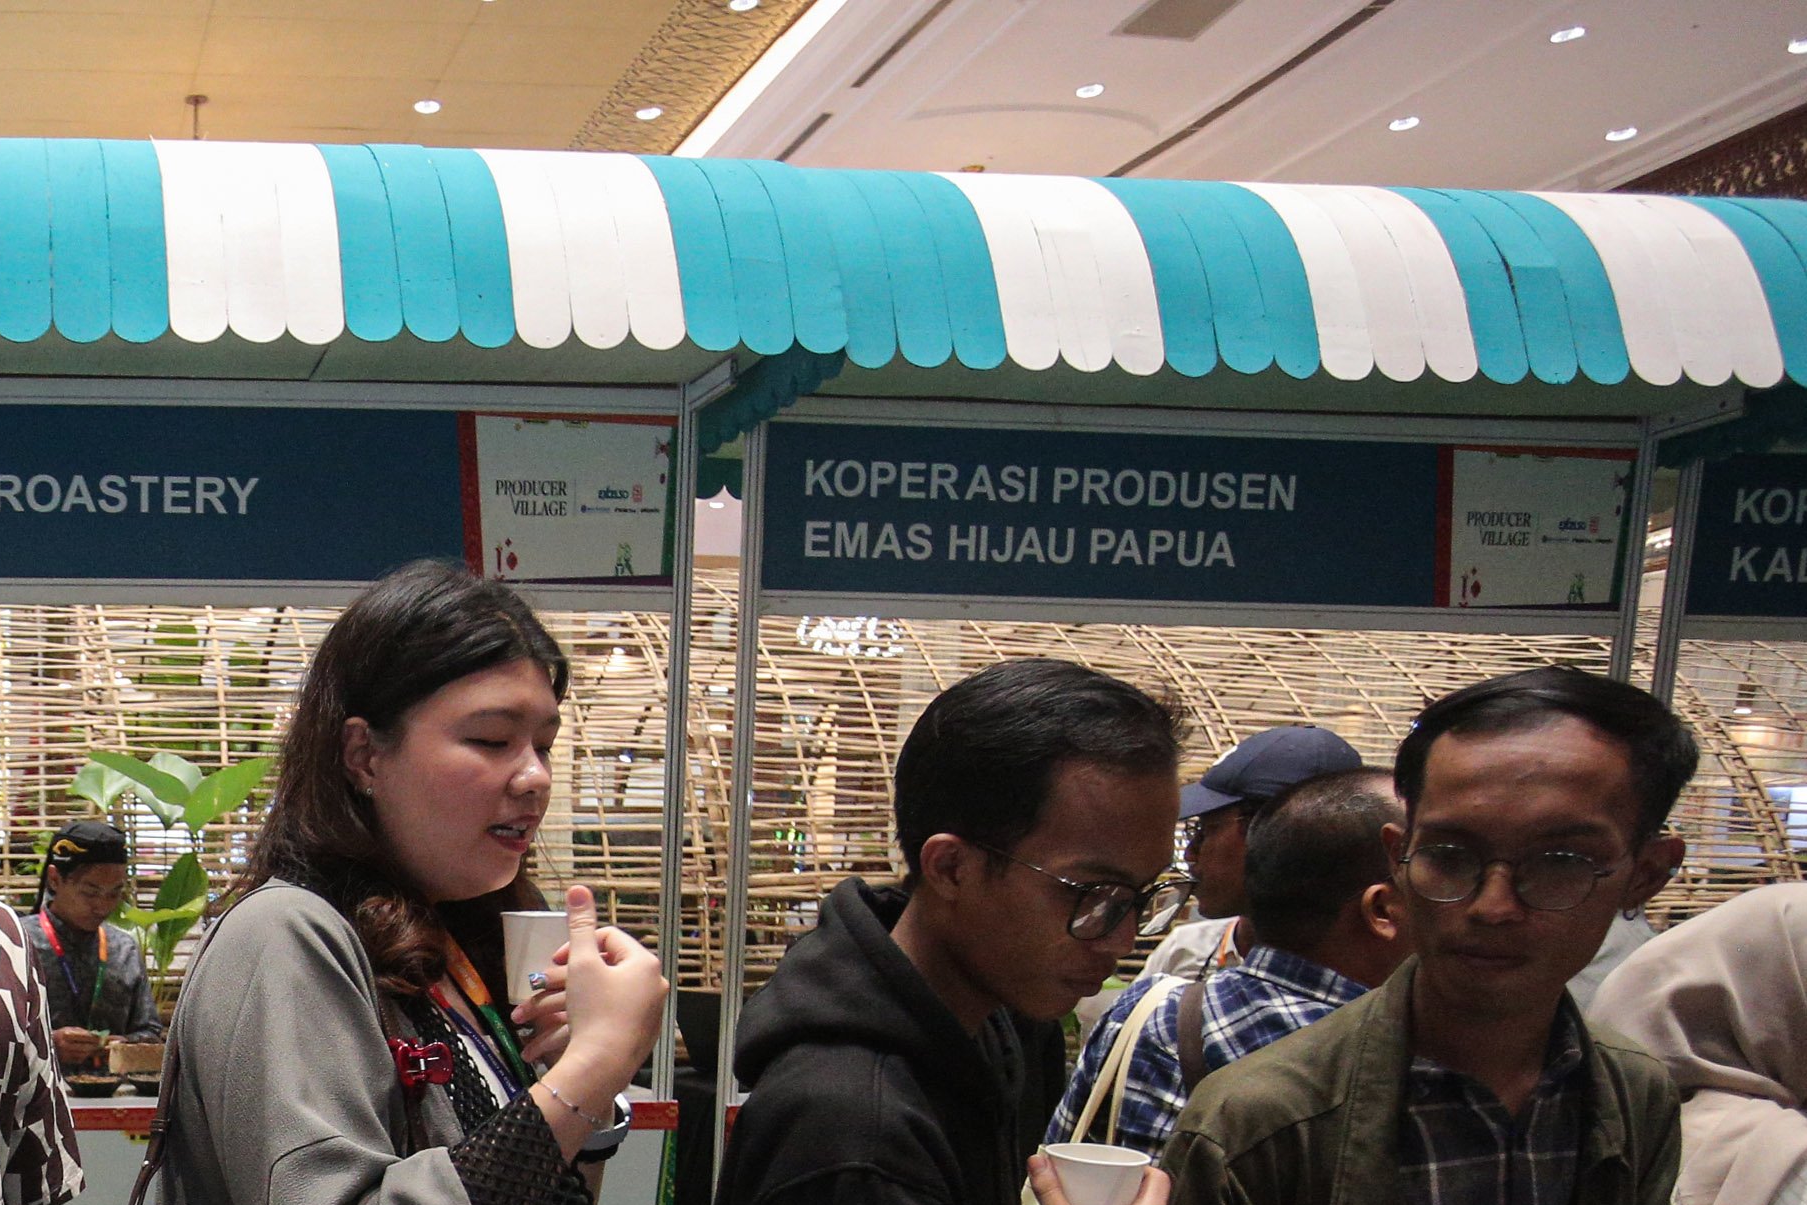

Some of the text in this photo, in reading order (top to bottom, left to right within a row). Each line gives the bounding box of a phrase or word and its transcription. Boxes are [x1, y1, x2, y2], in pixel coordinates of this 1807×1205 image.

[495, 479, 567, 497] PRODUCER
[804, 459, 1297, 511] KOPERASI PRODUSEN
[511, 500, 567, 516] VILLAGE
[1466, 511, 1531, 528] PRODUCER
[804, 521, 1236, 568] EMAS HIJAU PAPUA
[1479, 531, 1530, 547] VILLAGE
